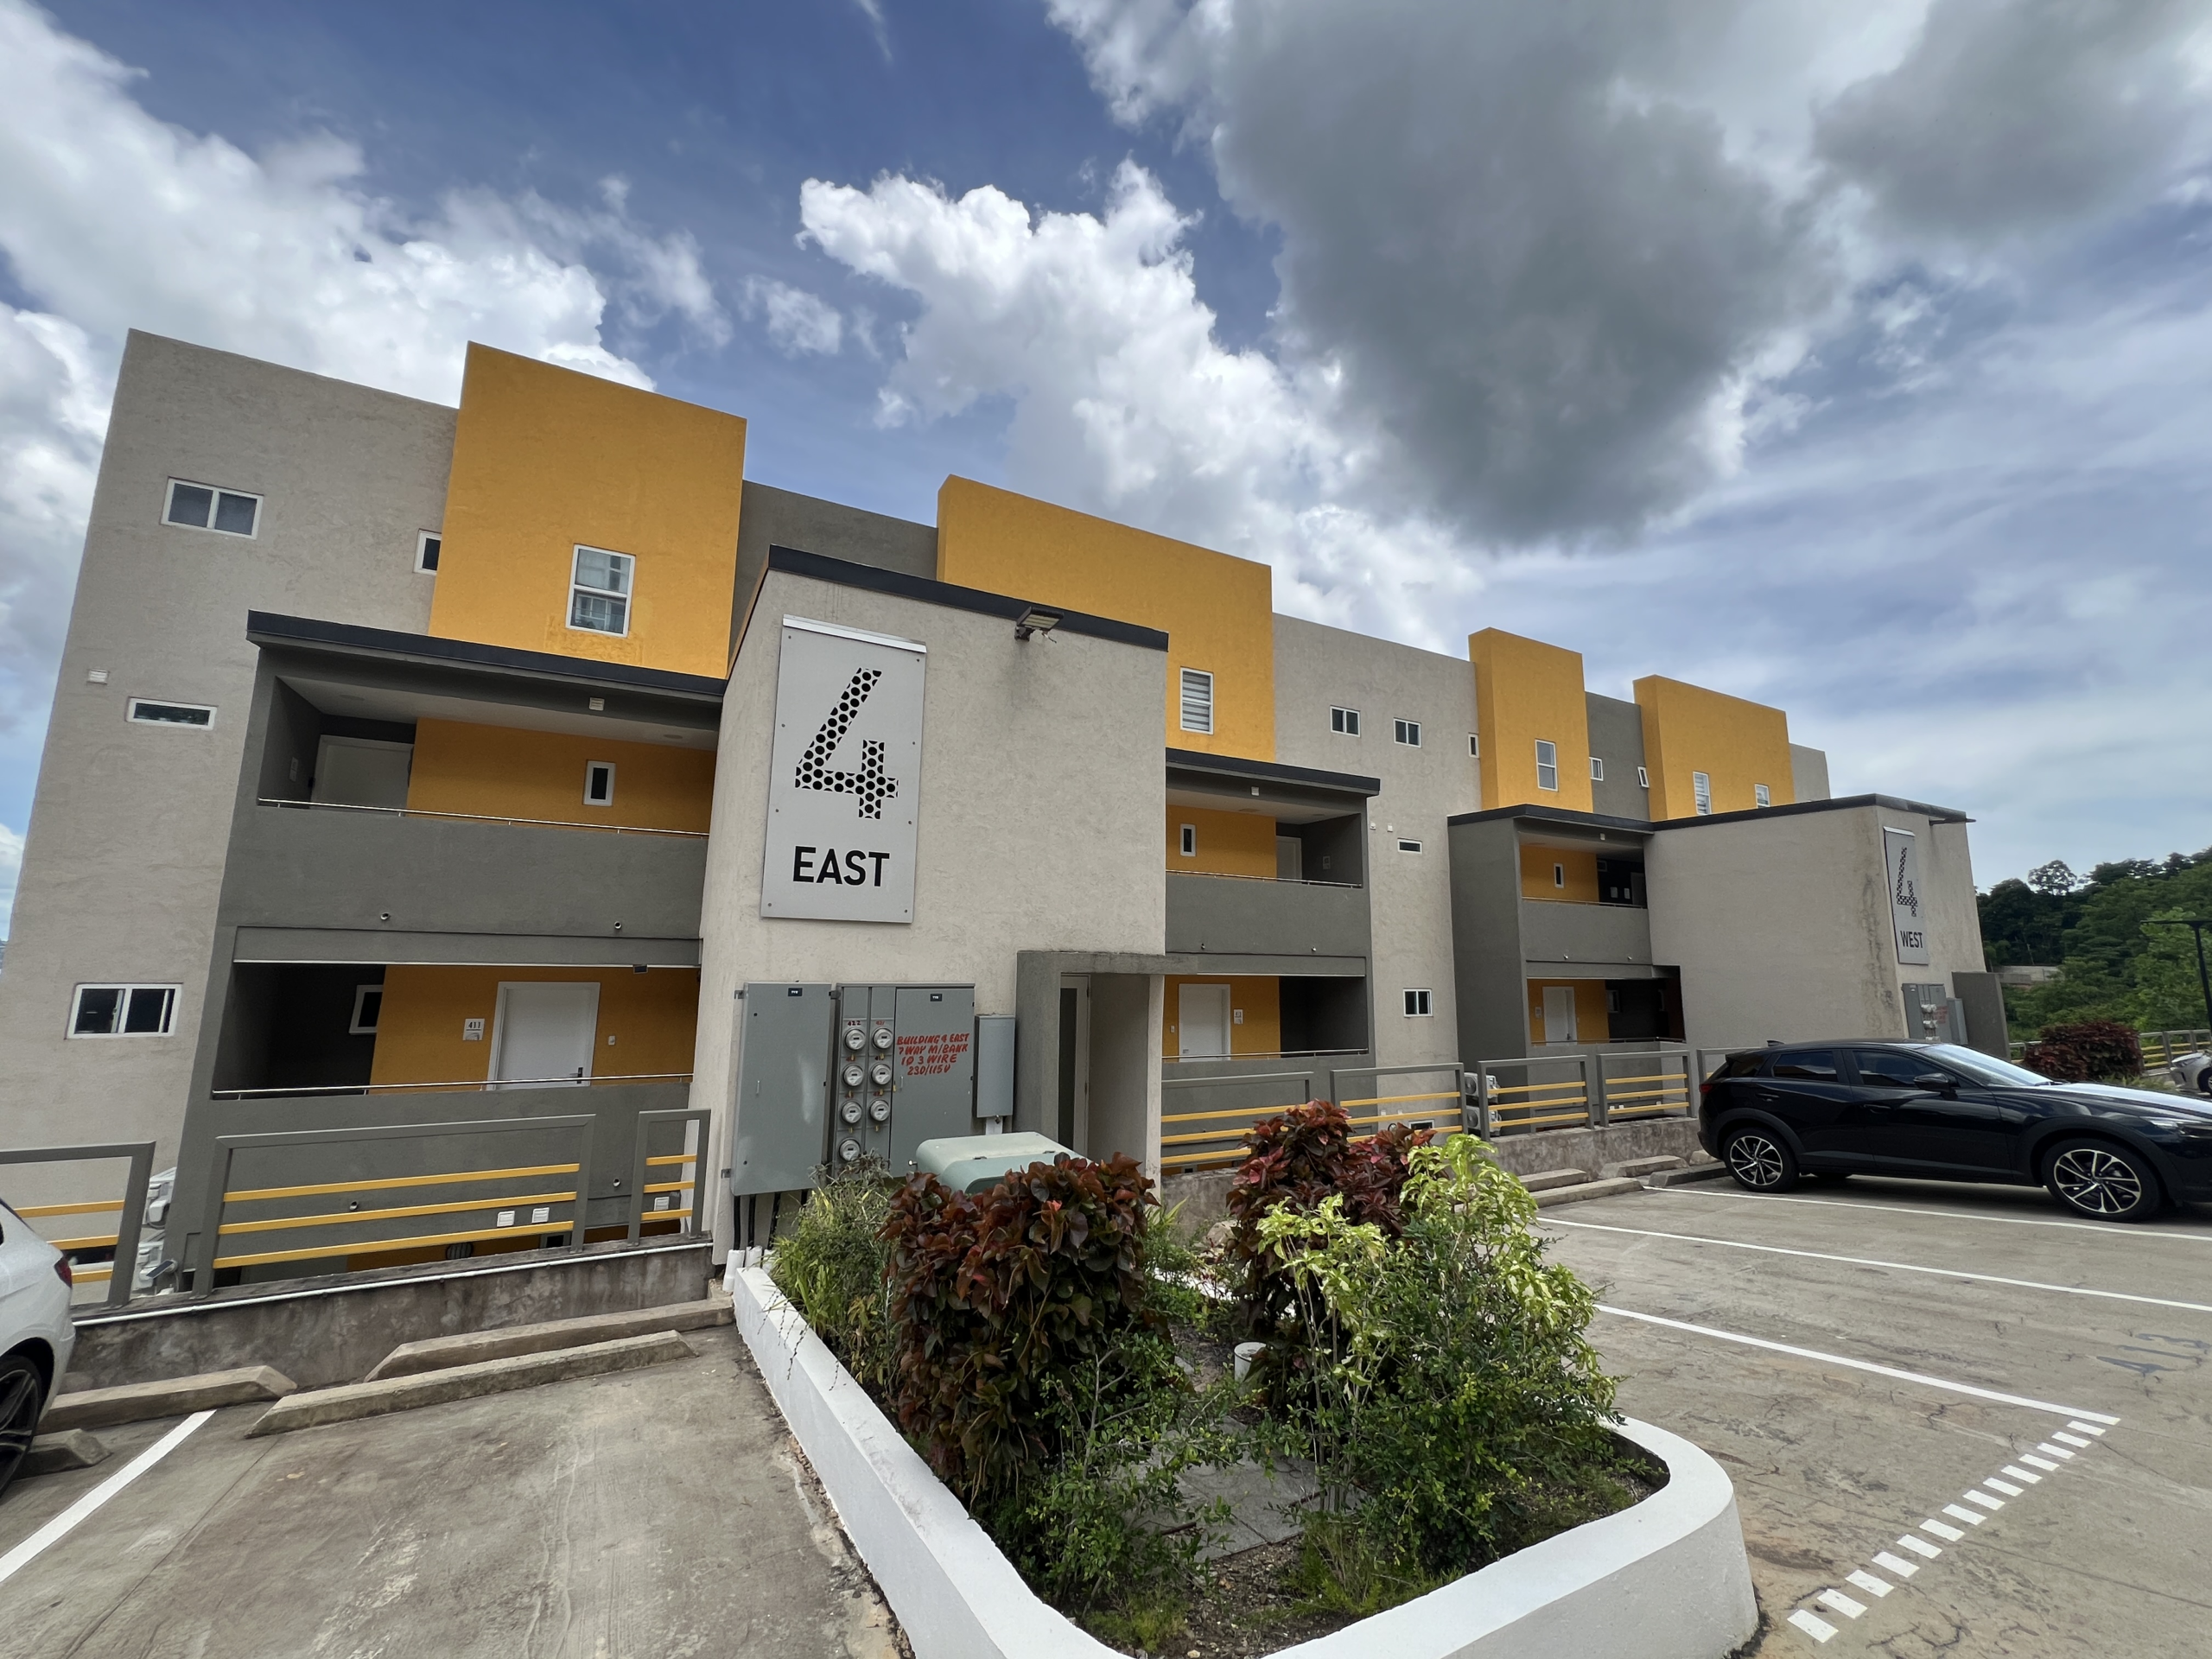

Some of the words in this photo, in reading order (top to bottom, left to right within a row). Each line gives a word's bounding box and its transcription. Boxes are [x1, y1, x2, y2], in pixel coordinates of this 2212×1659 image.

[795, 667, 899, 819] 4
[793, 846, 890, 887] EAST
[1897, 847, 1917, 917] 4
[1900, 931, 1923, 948] WEST
[897, 1035, 940, 1045] BUILDING
[950, 1033, 969, 1042] EAST
[928, 1044, 968, 1054] M/BANK
[918, 1056, 924, 1065] 3
[926, 1054, 957, 1064] WIRE
